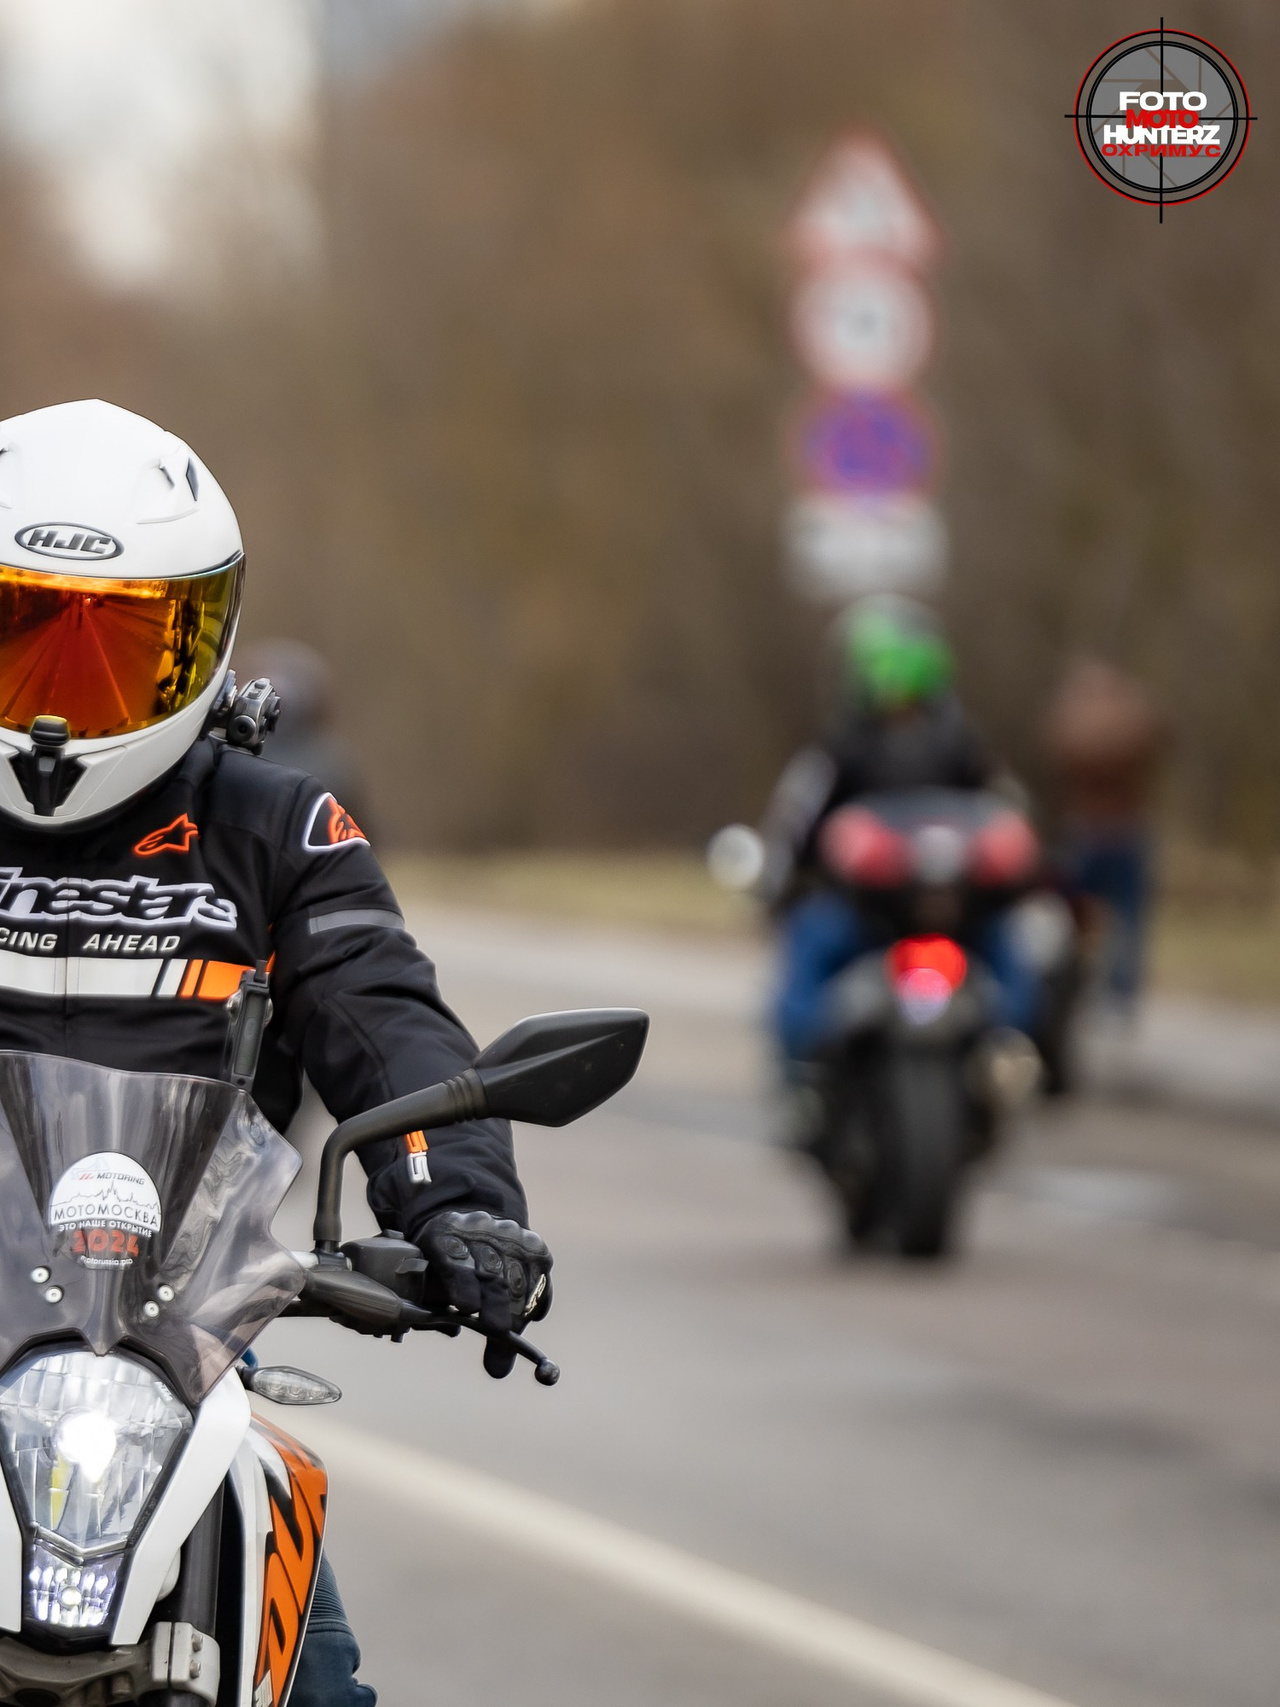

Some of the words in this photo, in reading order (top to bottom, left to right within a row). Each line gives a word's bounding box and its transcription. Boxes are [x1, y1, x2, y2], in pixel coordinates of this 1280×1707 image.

[26, 528, 113, 555] HJC
[82, 933, 181, 952] AHEAD
[96, 1172, 145, 1186] MOTORING
[53, 1203, 159, 1229] МОТОМОСКВА
[58, 1222, 77, 1232] ЭТО
[78, 1219, 107, 1229] НАШЕ
[108, 1219, 153, 1239] ОТКРЫТИЕ
